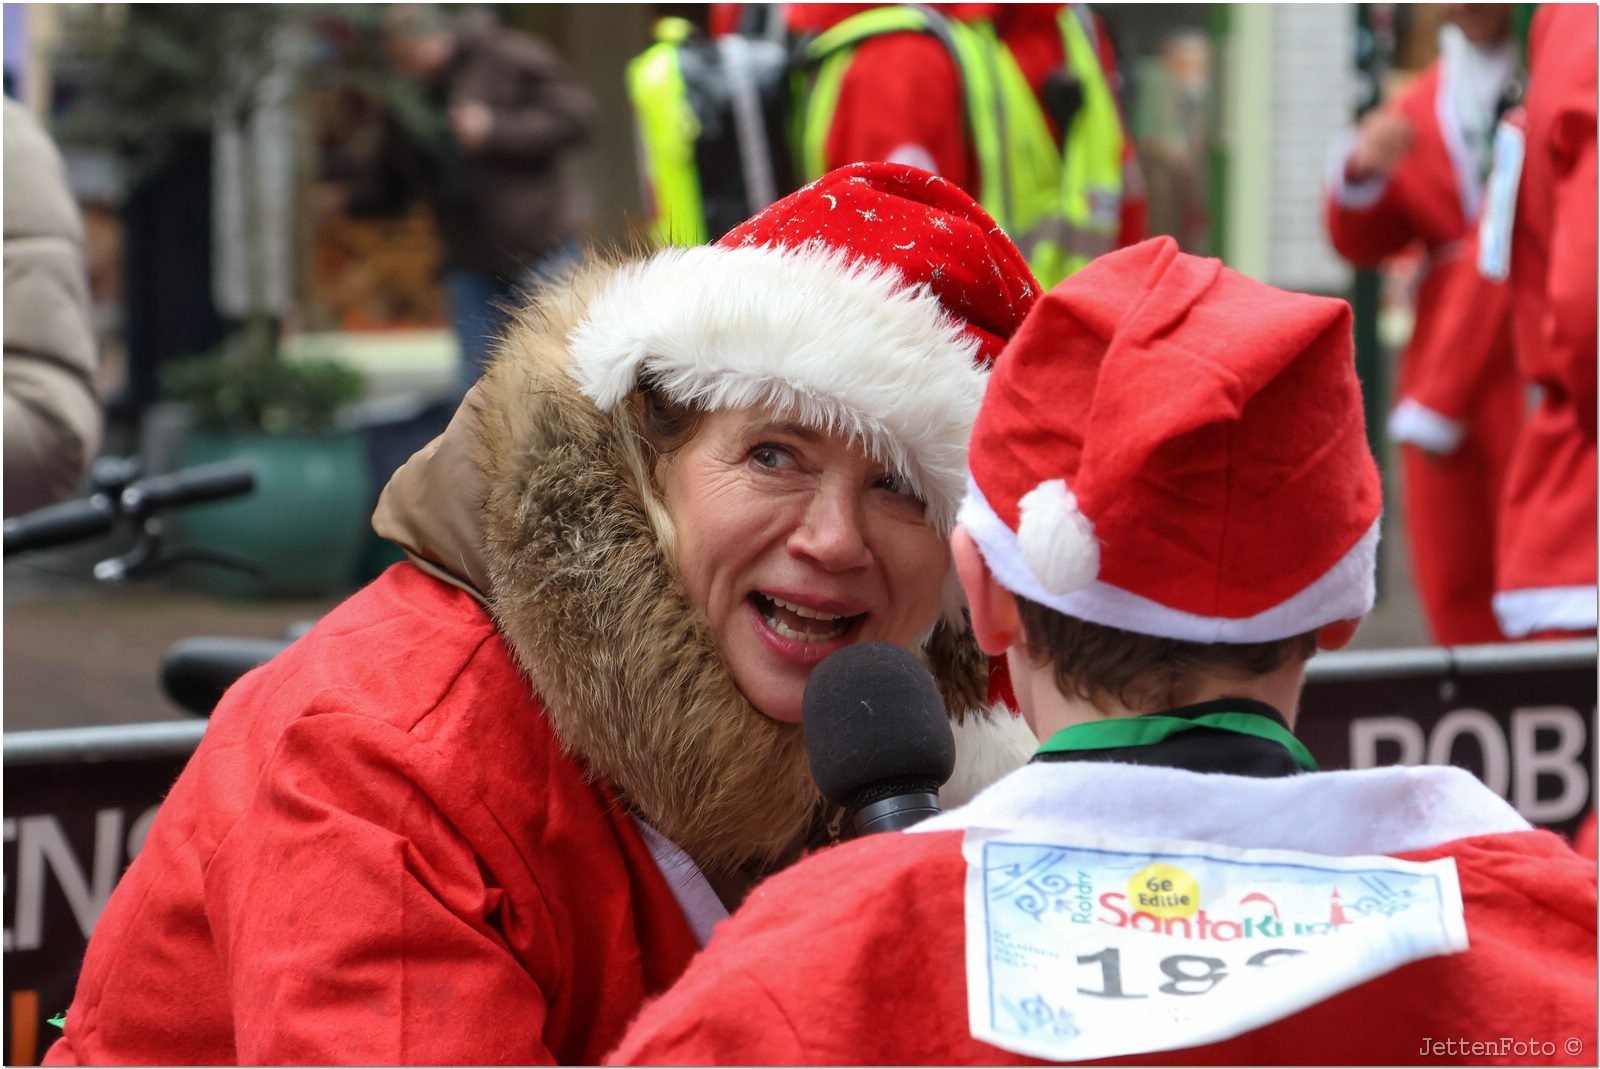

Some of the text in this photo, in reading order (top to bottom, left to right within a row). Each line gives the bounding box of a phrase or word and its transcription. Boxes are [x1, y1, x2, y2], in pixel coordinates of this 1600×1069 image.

[1350, 705, 1597, 823] OB
[1071, 870, 1093, 924] Rotary
[1137, 893, 1191, 908] Editie
[1146, 877, 1174, 893] 6e
[1076, 947, 1310, 999] 18
